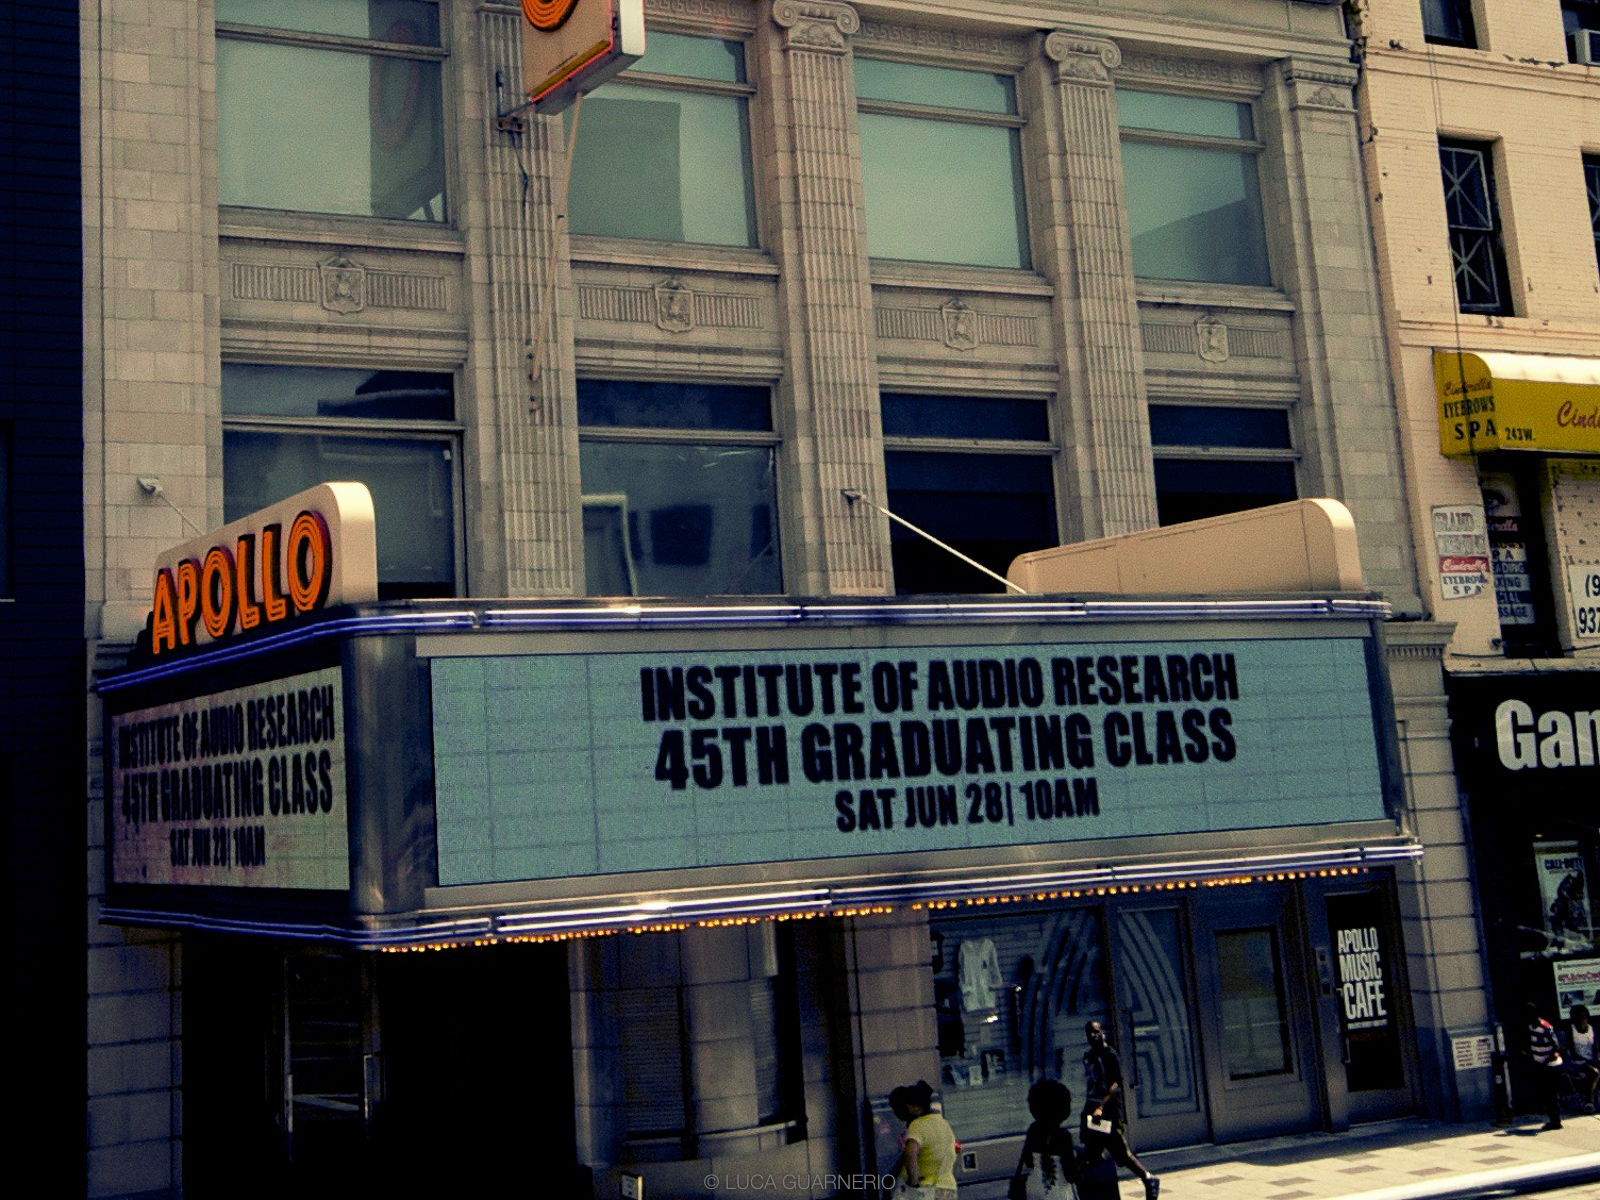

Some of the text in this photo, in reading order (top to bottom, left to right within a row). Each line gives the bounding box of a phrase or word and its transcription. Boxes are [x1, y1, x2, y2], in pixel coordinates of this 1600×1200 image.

[1444, 396, 1496, 418] EYEBROWS
[1454, 419, 1496, 440] SPA
[152, 510, 332, 654] APOLLO
[640, 653, 1239, 721] INSTITUTE OF AUDIO RESEARCH
[119, 684, 335, 769] INSTITUTE OF AUDIO RESEARCH
[655, 707, 1238, 790] 45TH GRADUATING CLASS
[122, 749, 333, 824] 45TH GRADUATING CLASS
[835, 788, 896, 833] SAT
[905, 785, 959, 828] JUN
[1019, 777, 1100, 820] 10AM
[170, 828, 190, 867] SAT
[1337, 926, 1379, 954] APOLLO
[1339, 951, 1382, 982] MUSIC
[1343, 980, 1387, 1020] CAFE
